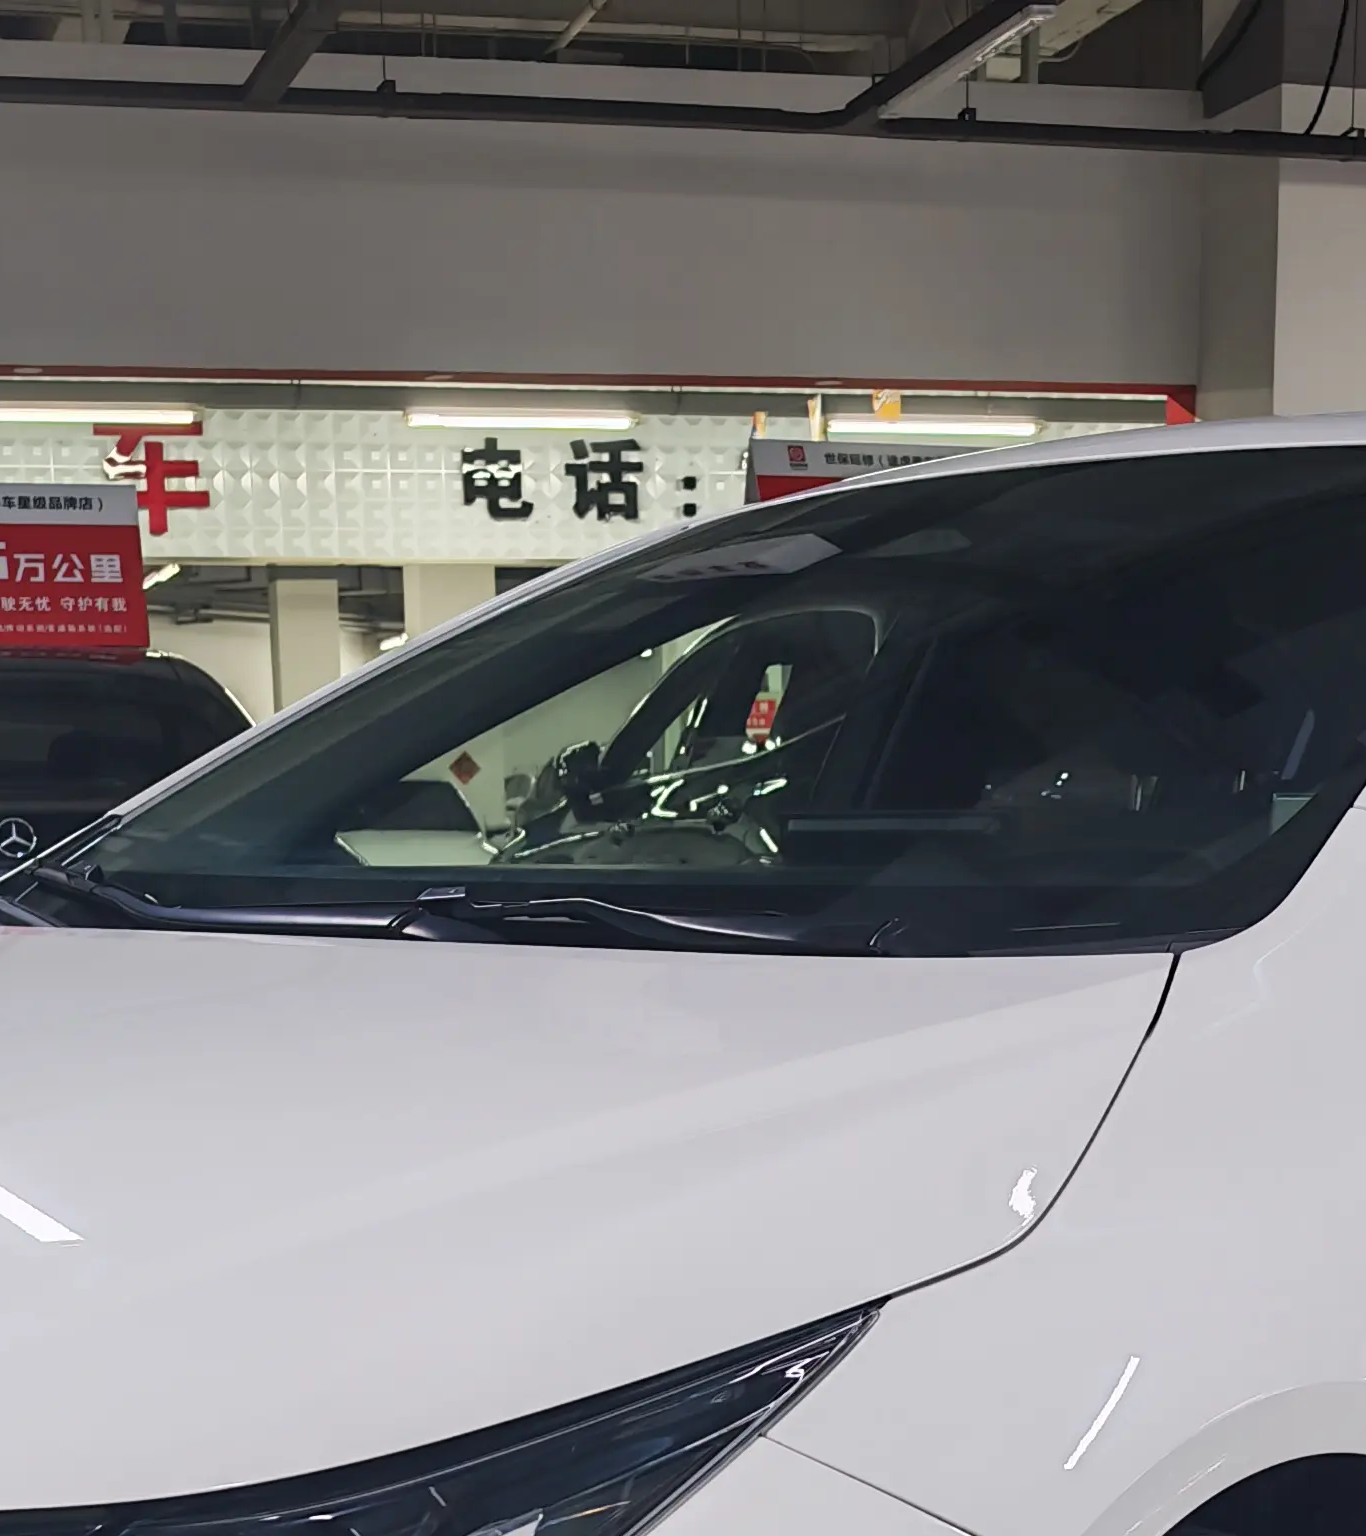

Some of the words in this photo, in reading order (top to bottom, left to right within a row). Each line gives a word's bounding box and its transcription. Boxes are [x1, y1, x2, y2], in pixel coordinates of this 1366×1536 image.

[92, 421, 211, 536] 车
[60, 596, 128, 613] 守护有我
